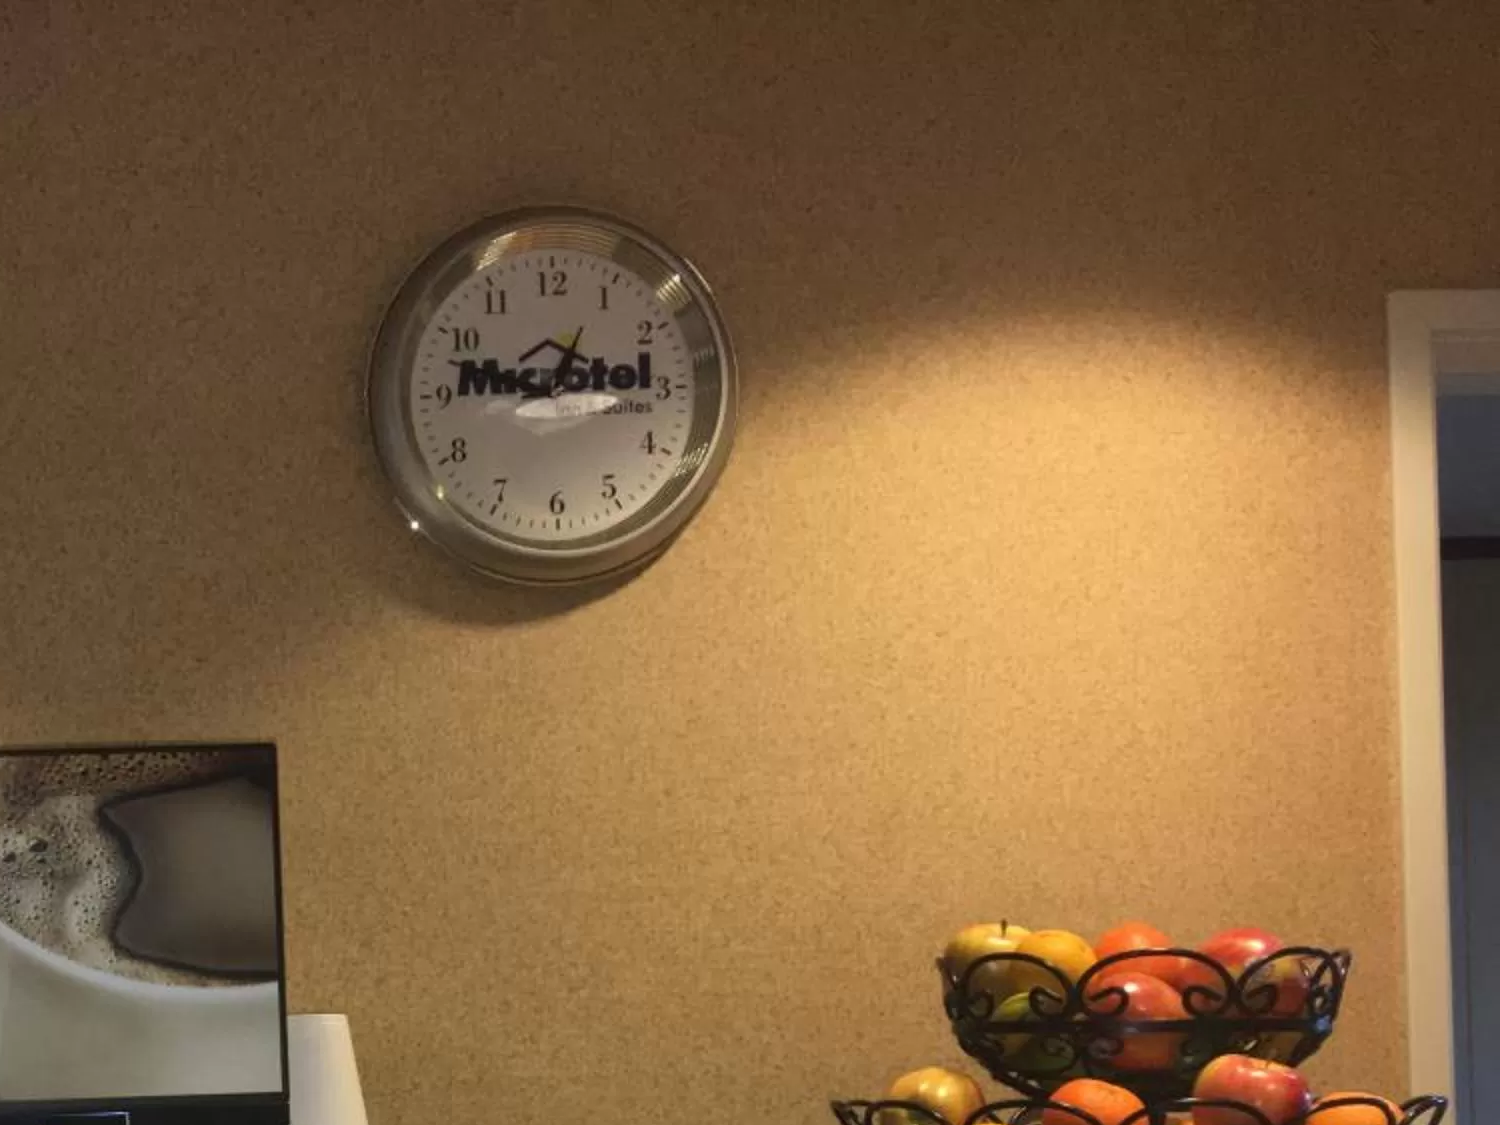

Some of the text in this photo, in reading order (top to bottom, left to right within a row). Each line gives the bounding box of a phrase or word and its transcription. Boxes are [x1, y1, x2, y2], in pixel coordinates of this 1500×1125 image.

[537, 271, 568, 297] 12
[484, 290, 507, 316] 11
[598, 287, 610, 311] 1
[451, 327, 480, 352] 10
[637, 320, 654, 346] 2
[435, 384, 453, 409] 9
[655, 375, 672, 401] 3
[450, 437, 468, 463] 8
[639, 431, 657, 456] 4
[493, 478, 508, 503] 7
[601, 474, 617, 499] 5
[549, 490, 566, 516] 6
